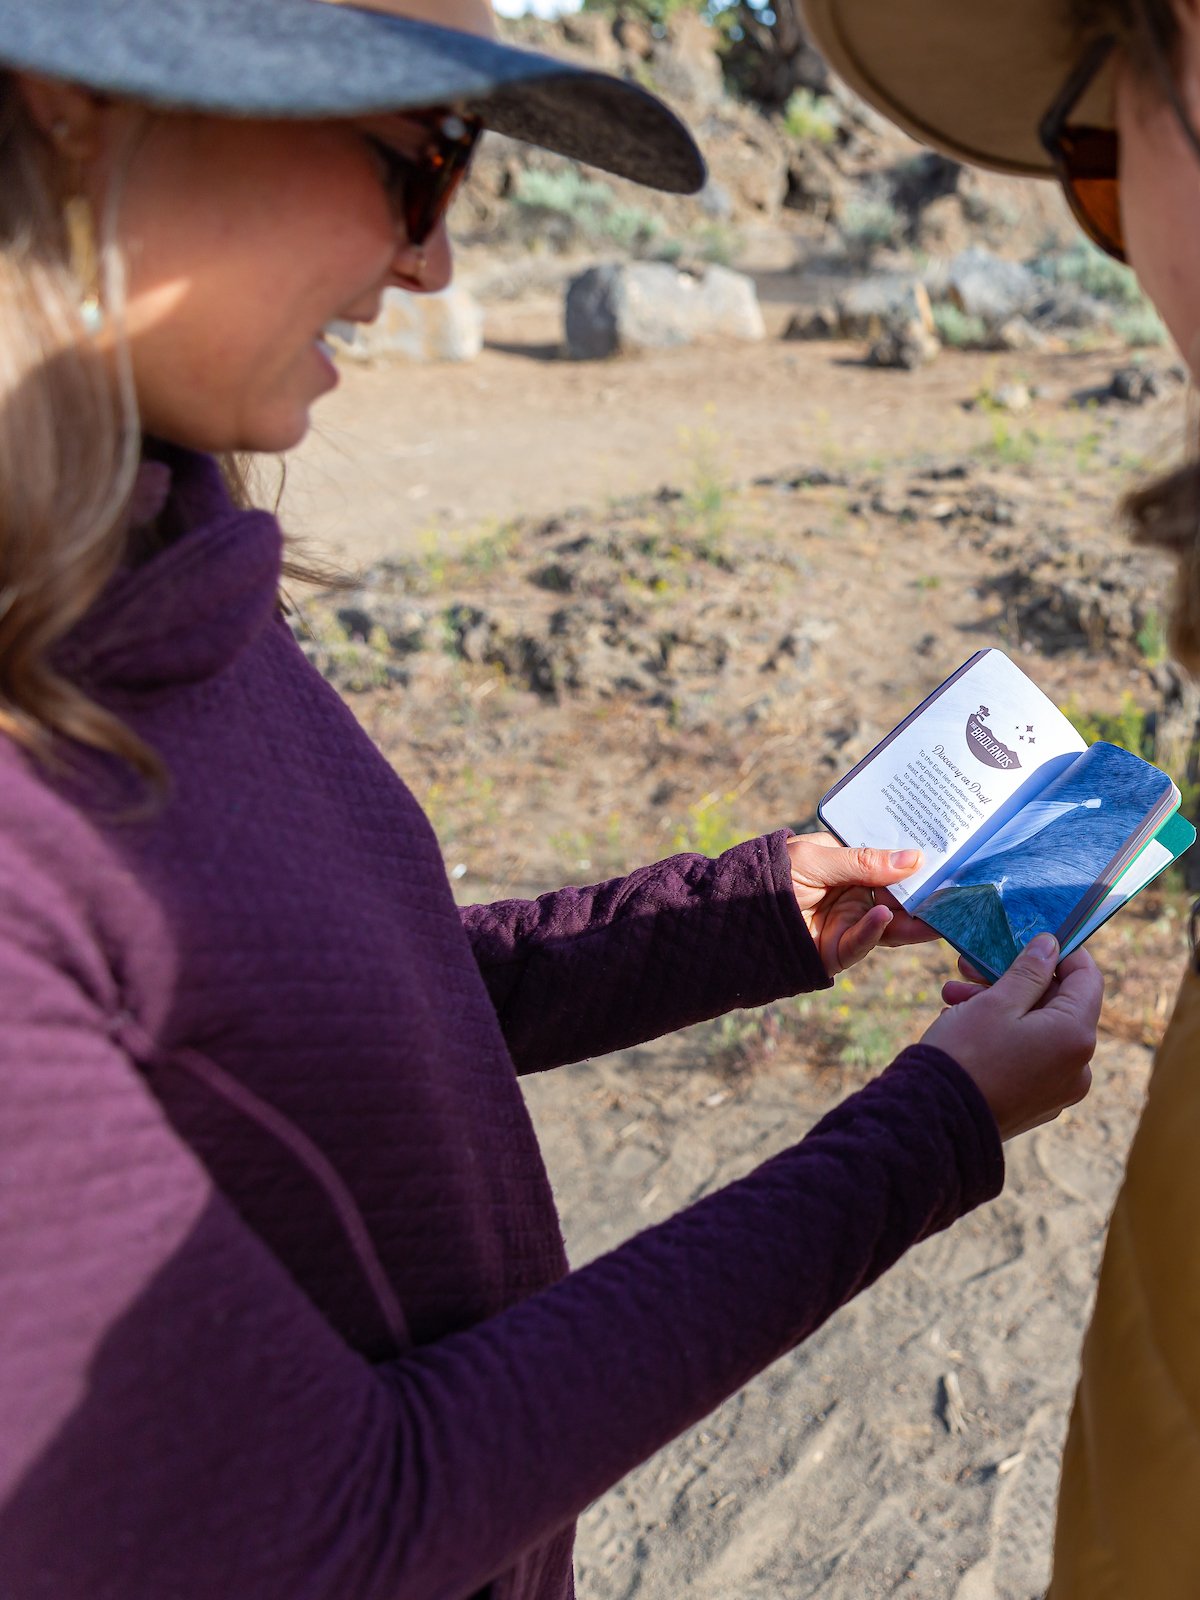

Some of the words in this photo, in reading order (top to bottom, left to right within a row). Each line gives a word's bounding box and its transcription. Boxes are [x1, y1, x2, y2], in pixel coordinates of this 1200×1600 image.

[970, 721, 979, 730] THE
[971, 727, 1013, 768] BADLANDS
[903, 772, 910, 780] to
[909, 778, 920, 790] seek
[919, 789, 932, 804] them
[931, 802, 941, 813] out.
[941, 810, 951, 823] This
[950, 820, 956, 828] is
[906, 762, 918, 777] least,
[918, 774, 926, 783] for
[925, 781, 938, 796] those
[937, 795, 951, 810] brave
[950, 809, 970, 829] enough
[915, 760, 926, 771] and
[924, 769, 940, 785] plenty
[939, 783, 947, 791] of
[919, 749, 926, 758] To
[924, 755, 933, 765] the
[932, 764, 944, 776] East
[942, 773, 951, 784] lies
[950, 783, 969, 802] endless
[967, 801, 985, 819] desert
[932, 744, 963, 778] Discovery
[960, 776, 971, 785] on
[968, 782, 992, 804] Draft
[881, 788, 896, 804] always
[895, 803, 918, 826] rewarded
[916, 825, 927, 837] with
[929, 840, 938, 849] sip
[885, 805, 909, 832] something
[908, 830, 926, 849] special.
[886, 782, 906, 801] journey
[905, 799, 915, 811] into
[914, 809, 923, 819] the
[922, 818, 944, 841] unknown
[942, 839, 949, 847] is
[893, 774, 905, 787] land
[909, 790, 933, 819] exploration,
[933, 817, 949, 833] where
[947, 831, 957, 842] the
